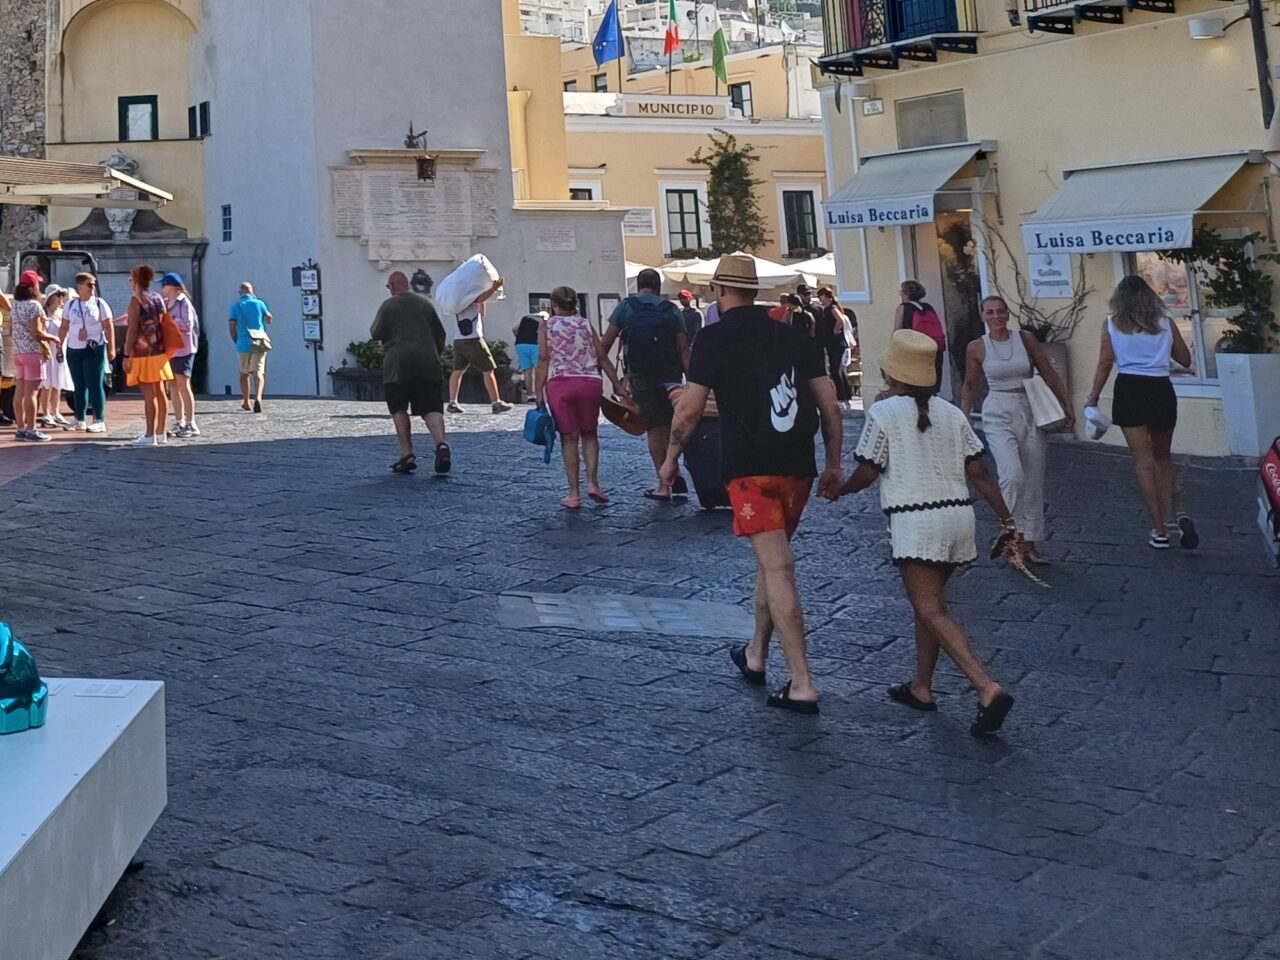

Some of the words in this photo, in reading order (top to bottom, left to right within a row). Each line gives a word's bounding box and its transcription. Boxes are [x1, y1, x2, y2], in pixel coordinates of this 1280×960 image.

[638, 103, 714, 115] MUNICIPIO
[827, 211, 864, 225] Luisa
[868, 204, 929, 222] Beccaria
[1035, 232, 1085, 248] Luisa
[1091, 227, 1175, 246] Beccaria
